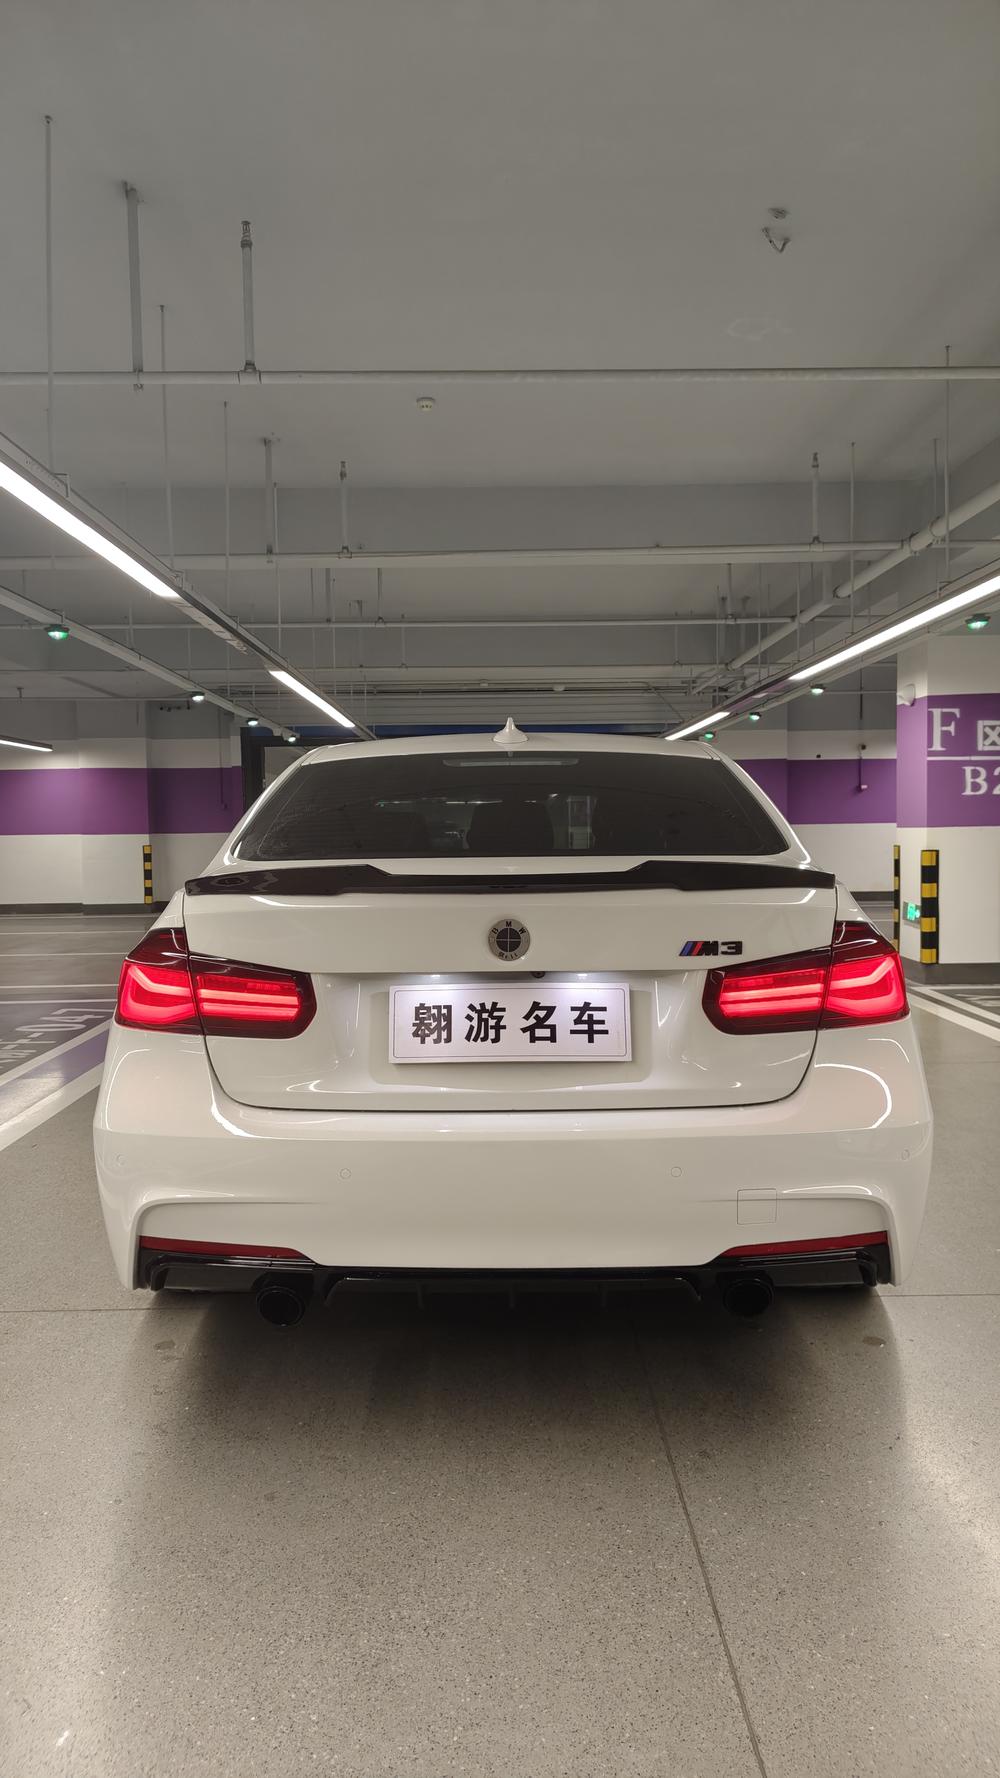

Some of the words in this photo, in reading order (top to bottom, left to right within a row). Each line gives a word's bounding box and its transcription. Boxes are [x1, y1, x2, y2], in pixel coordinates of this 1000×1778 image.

[491, 920, 527, 935] BMW
[680, 940, 743, 957] M3
[412, 1001, 609, 1044] 翱游名车
